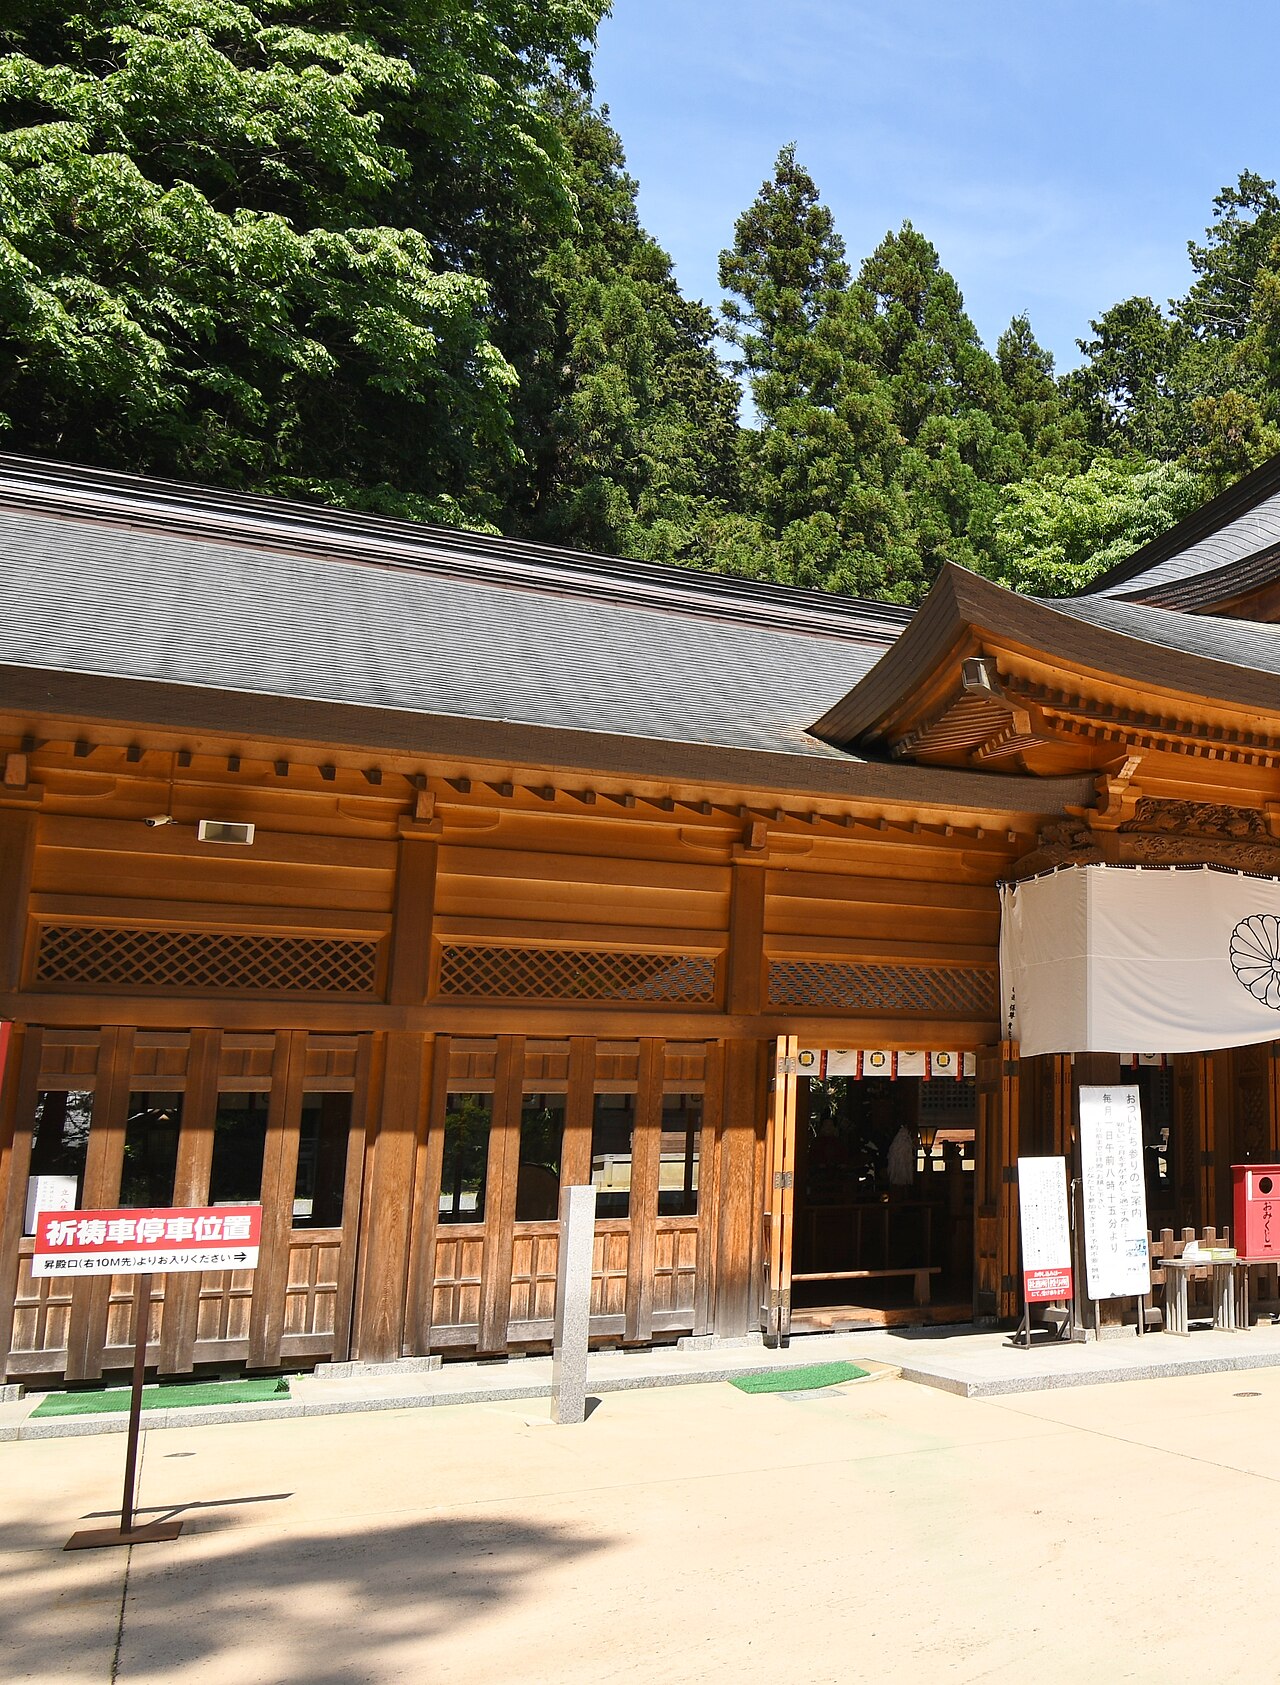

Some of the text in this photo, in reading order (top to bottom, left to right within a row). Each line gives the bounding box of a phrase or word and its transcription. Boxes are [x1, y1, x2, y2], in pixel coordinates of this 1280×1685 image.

[1103, 1093, 1117, 1253] 毎月一日午前八時十五分より
[1127, 1093, 1142, 1218] おついたち参りのご案内
[45, 1215, 252, 1246] 祈祷車停車位置
[1262, 1201, 1273, 1243] おみくじ
